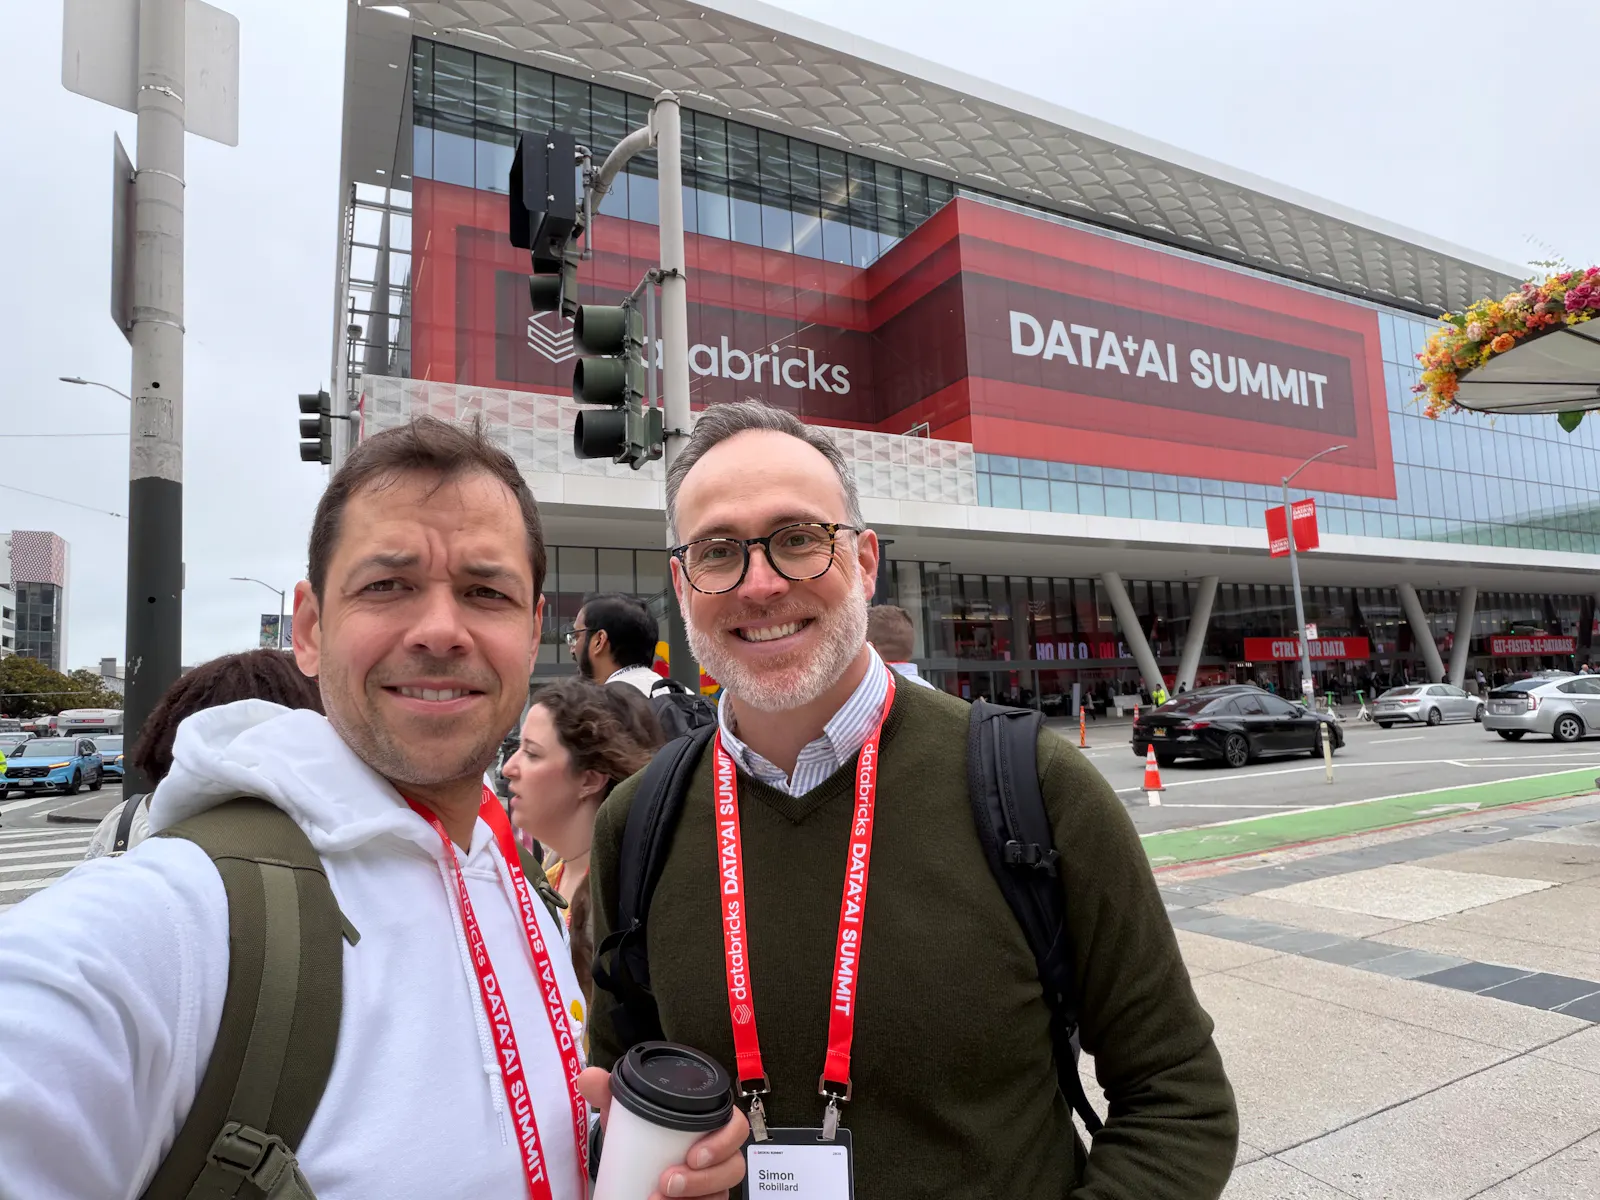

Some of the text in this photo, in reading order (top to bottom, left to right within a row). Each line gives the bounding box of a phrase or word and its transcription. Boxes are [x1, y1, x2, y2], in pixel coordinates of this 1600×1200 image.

[606, 334, 851, 395] aabricks
[1189, 349, 1328, 409] SUMMIT
[1272, 640, 1346, 658] CTRL YUR DATA
[718, 748, 734, 815] SUMMIT
[855, 743, 876, 835] databricks
[510, 863, 544, 952] SUMMIT
[725, 900, 747, 1000] databricks
[836, 929, 857, 1016] SUMMIT
[510, 1080, 544, 1185] SUMMIT
[758, 1169, 794, 1181] Simon
[759, 1182, 799, 1192] Robillard
